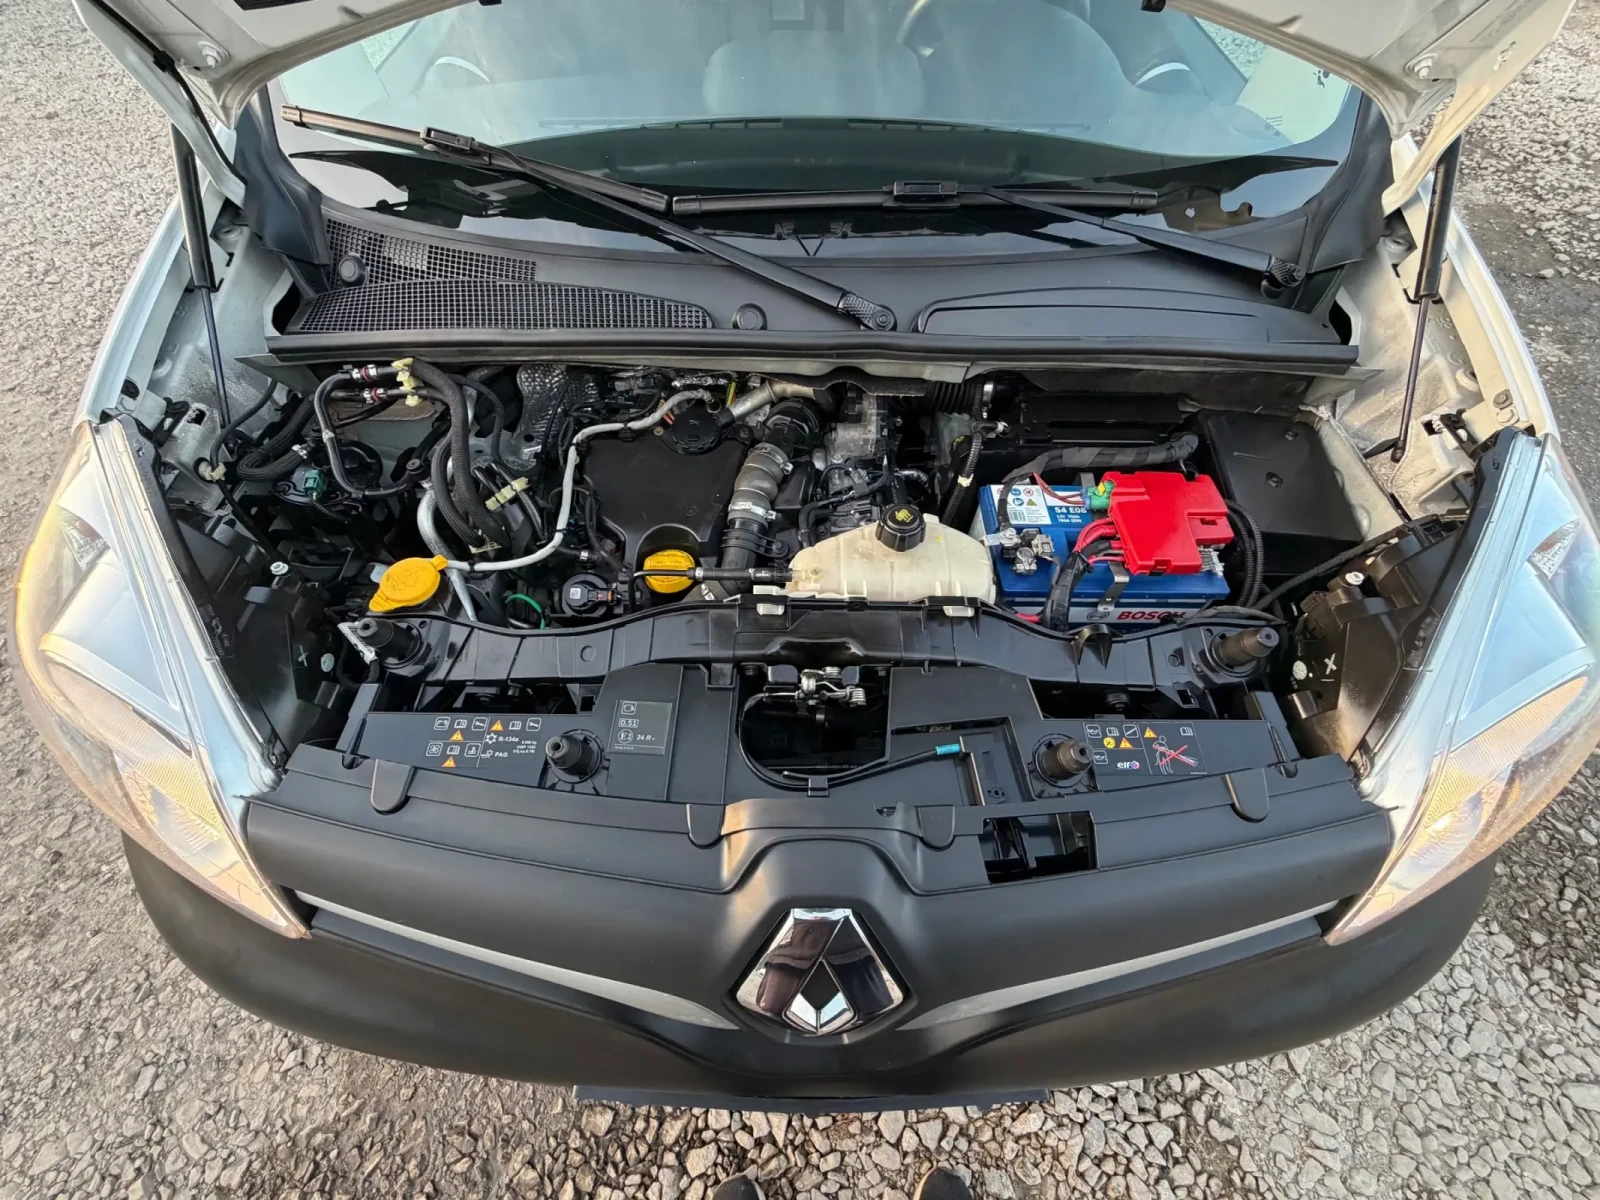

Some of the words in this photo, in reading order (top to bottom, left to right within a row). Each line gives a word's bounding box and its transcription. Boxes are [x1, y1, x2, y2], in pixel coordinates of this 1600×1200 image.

[1054, 506, 1067, 514] S4
[1069, 506, 1087, 514] E08
[1116, 761, 1131, 769] elf
